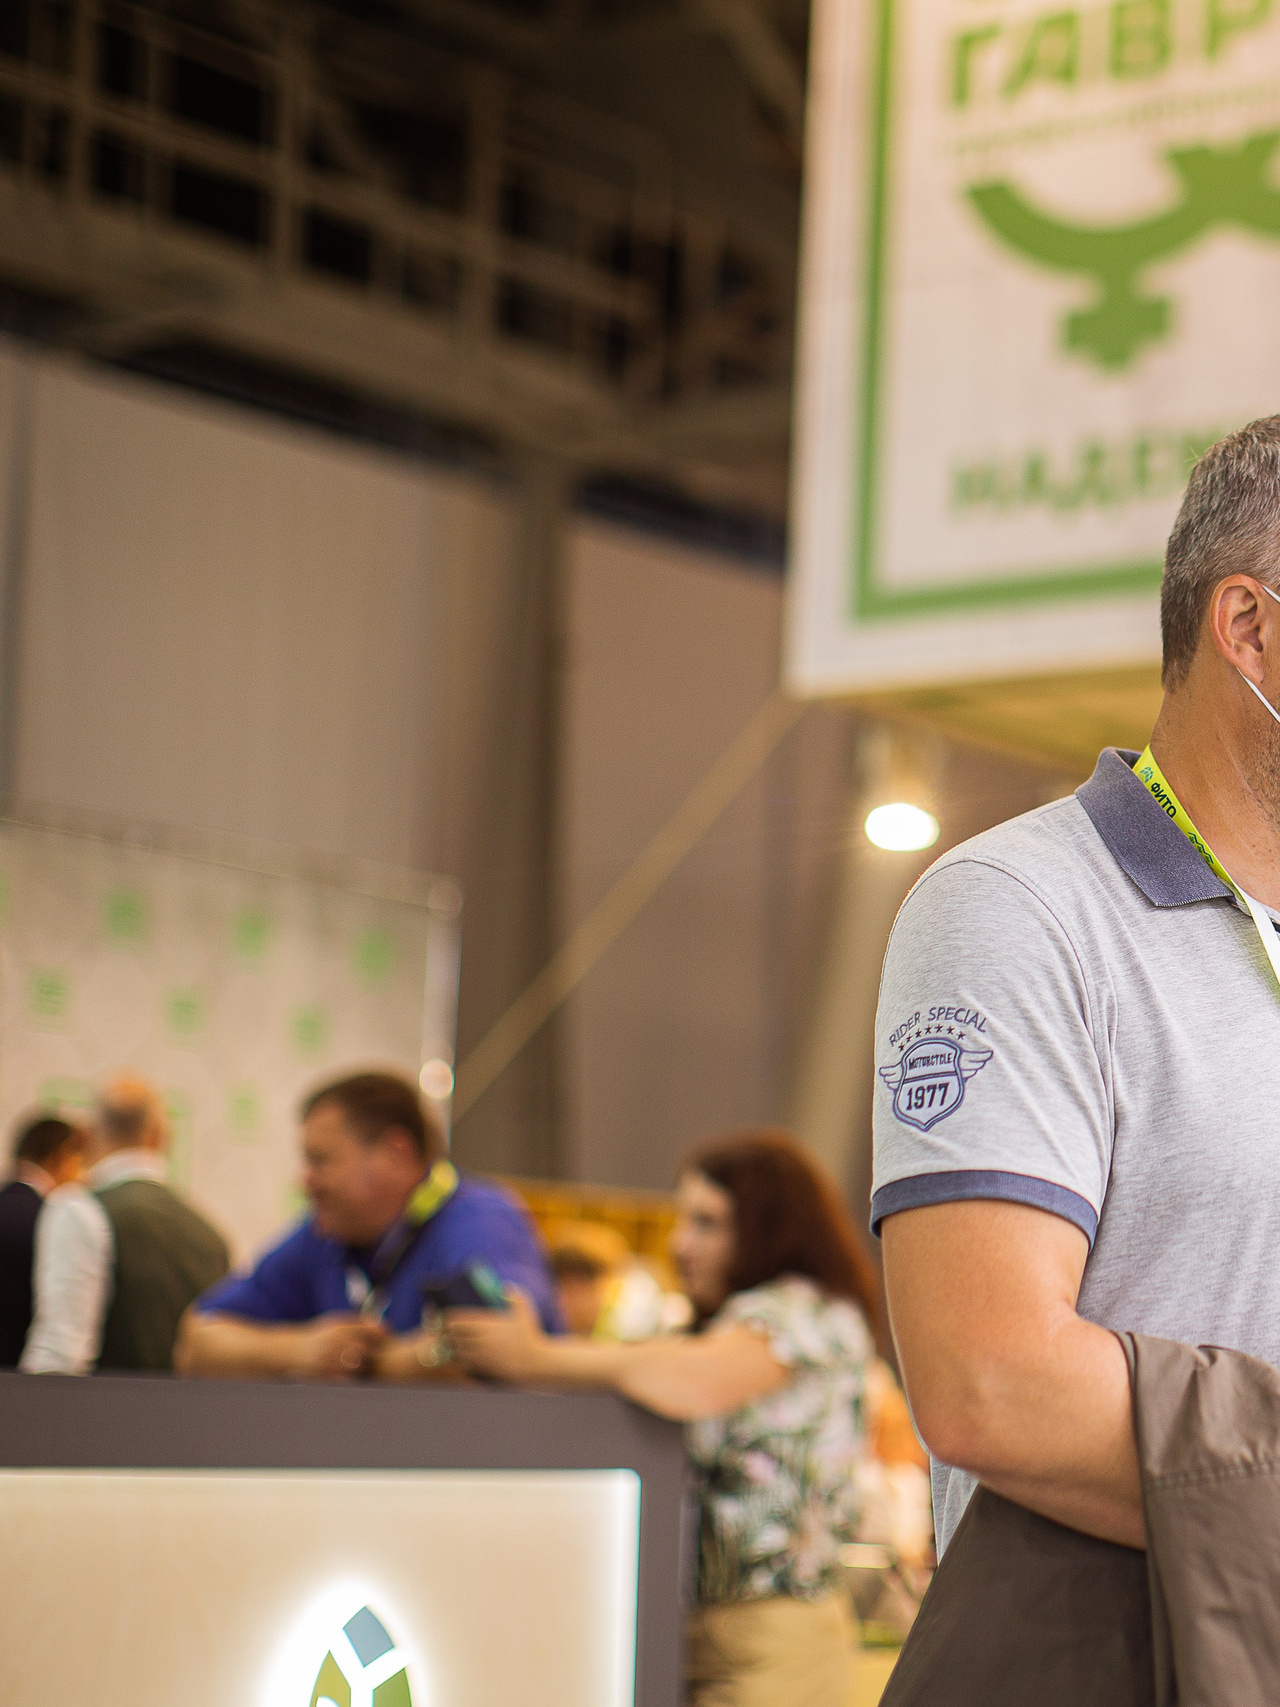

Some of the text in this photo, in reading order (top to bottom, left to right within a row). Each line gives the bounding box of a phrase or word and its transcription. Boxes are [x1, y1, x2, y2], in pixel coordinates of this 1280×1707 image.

[1150, 782, 1177, 818] ФИТО
[889, 1006, 987, 1047] RIDER SPECIAL
[908, 1052, 953, 1070] MOTORCYCLE
[906, 1082, 950, 1111] 1977
